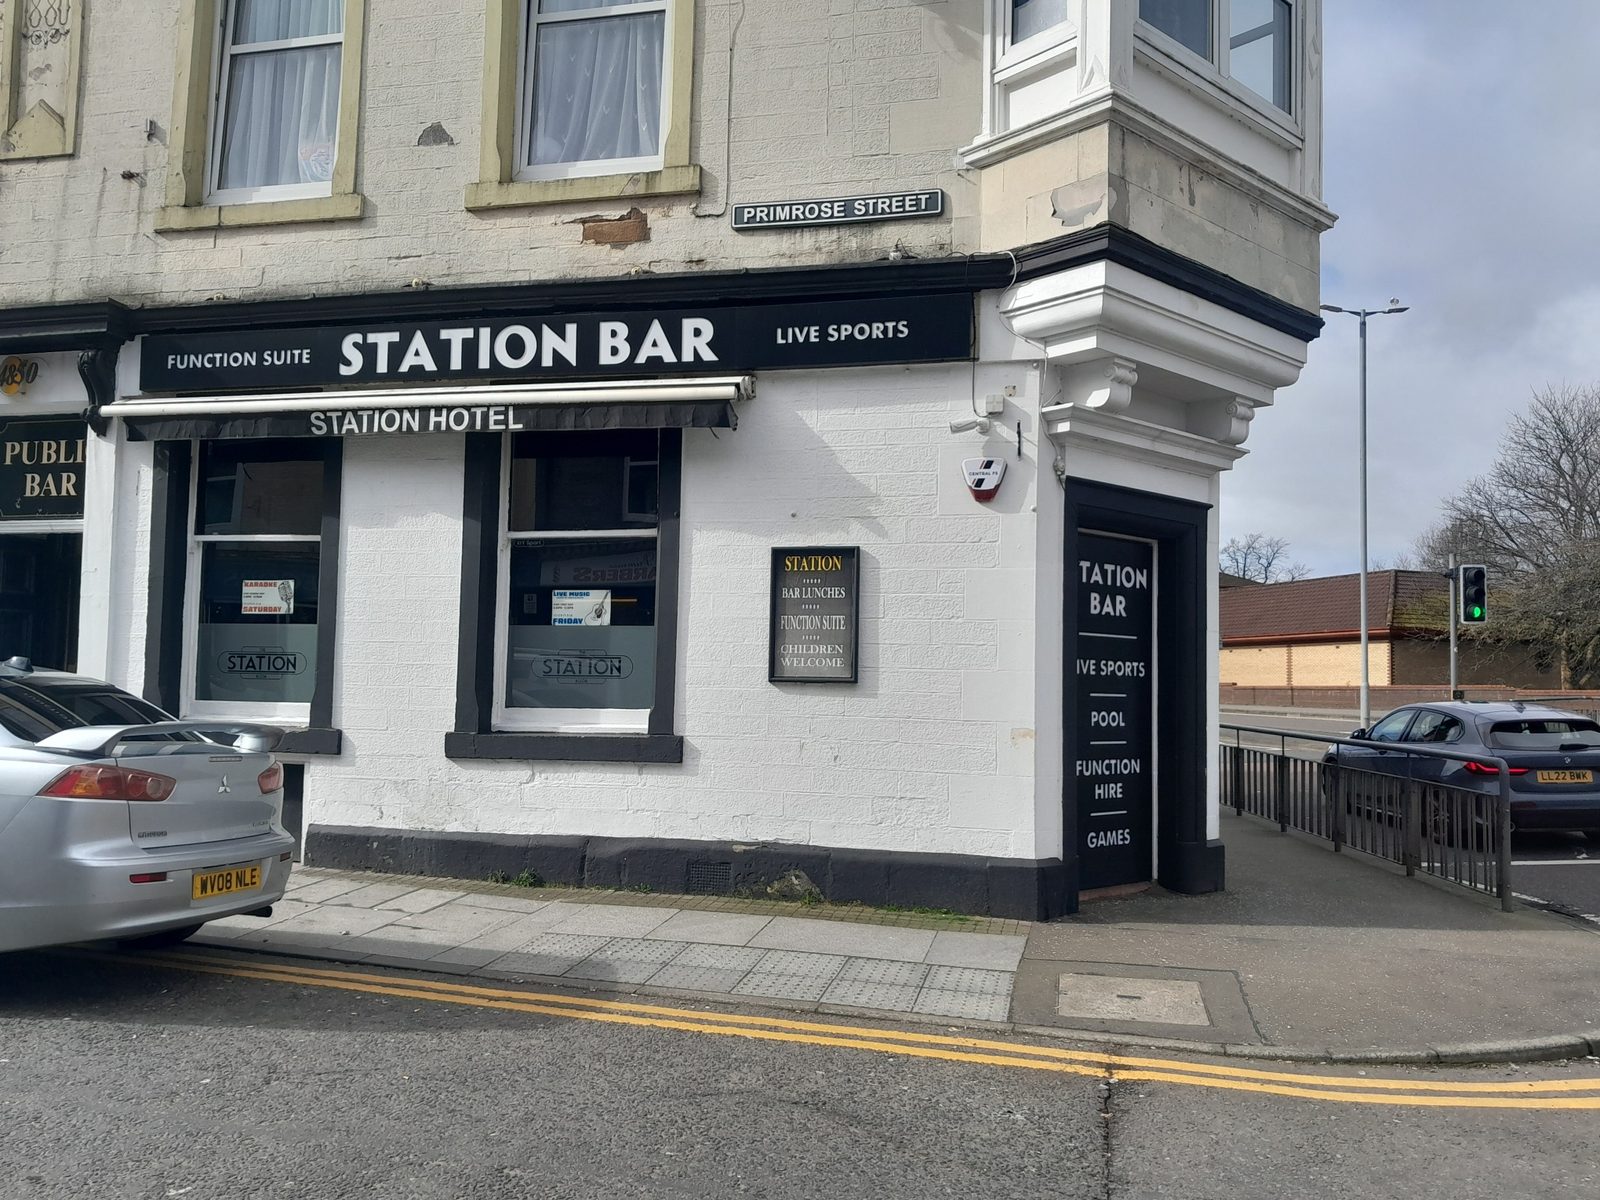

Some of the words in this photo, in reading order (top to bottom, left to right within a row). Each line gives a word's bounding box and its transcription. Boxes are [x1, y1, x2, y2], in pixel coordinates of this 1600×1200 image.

[743, 201, 845, 223] PRIMROSE
[853, 194, 930, 216] STREET
[776, 326, 820, 344] LIVE
[827, 320, 909, 342] SPORTS
[338, 322, 578, 376] STATION
[598, 317, 719, 366] BAR
[167, 350, 257, 369] FUNCTION
[262, 348, 311, 366] SUITE
[310, 408, 419, 436] STATION
[429, 405, 523, 432] HOTEL
[3, 439, 86, 466] PUBLI
[24, 472, 77, 497] BAR
[785, 556, 841, 571] STATION
[1078, 560, 1147, 589] TATION
[782, 587, 800, 598] BAR
[802, 587, 846, 598] LUNCHES
[1090, 592, 1127, 617] BAR
[780, 615, 821, 630] FUNCTION
[822, 615, 846, 630] SUITE
[780, 644, 844, 654] CHILDREN
[227, 655, 297, 671] STATION
[542, 659, 621, 675] STATION
[781, 657, 844, 667] WELCOME
[1076, 658, 1096, 675] IVE
[1100, 660, 1145, 677] SPORTS
[1091, 711, 1125, 727] POOL
[1076, 759, 1140, 776] FUNCTION
[1541, 771, 1567, 781] LL22
[1569, 771, 1588, 780] BWK
[1095, 783, 1123, 799] HIRE
[1087, 829, 1130, 848] GAMES
[200, 872, 233, 895] WV08
[235, 868, 257, 889] NLE
